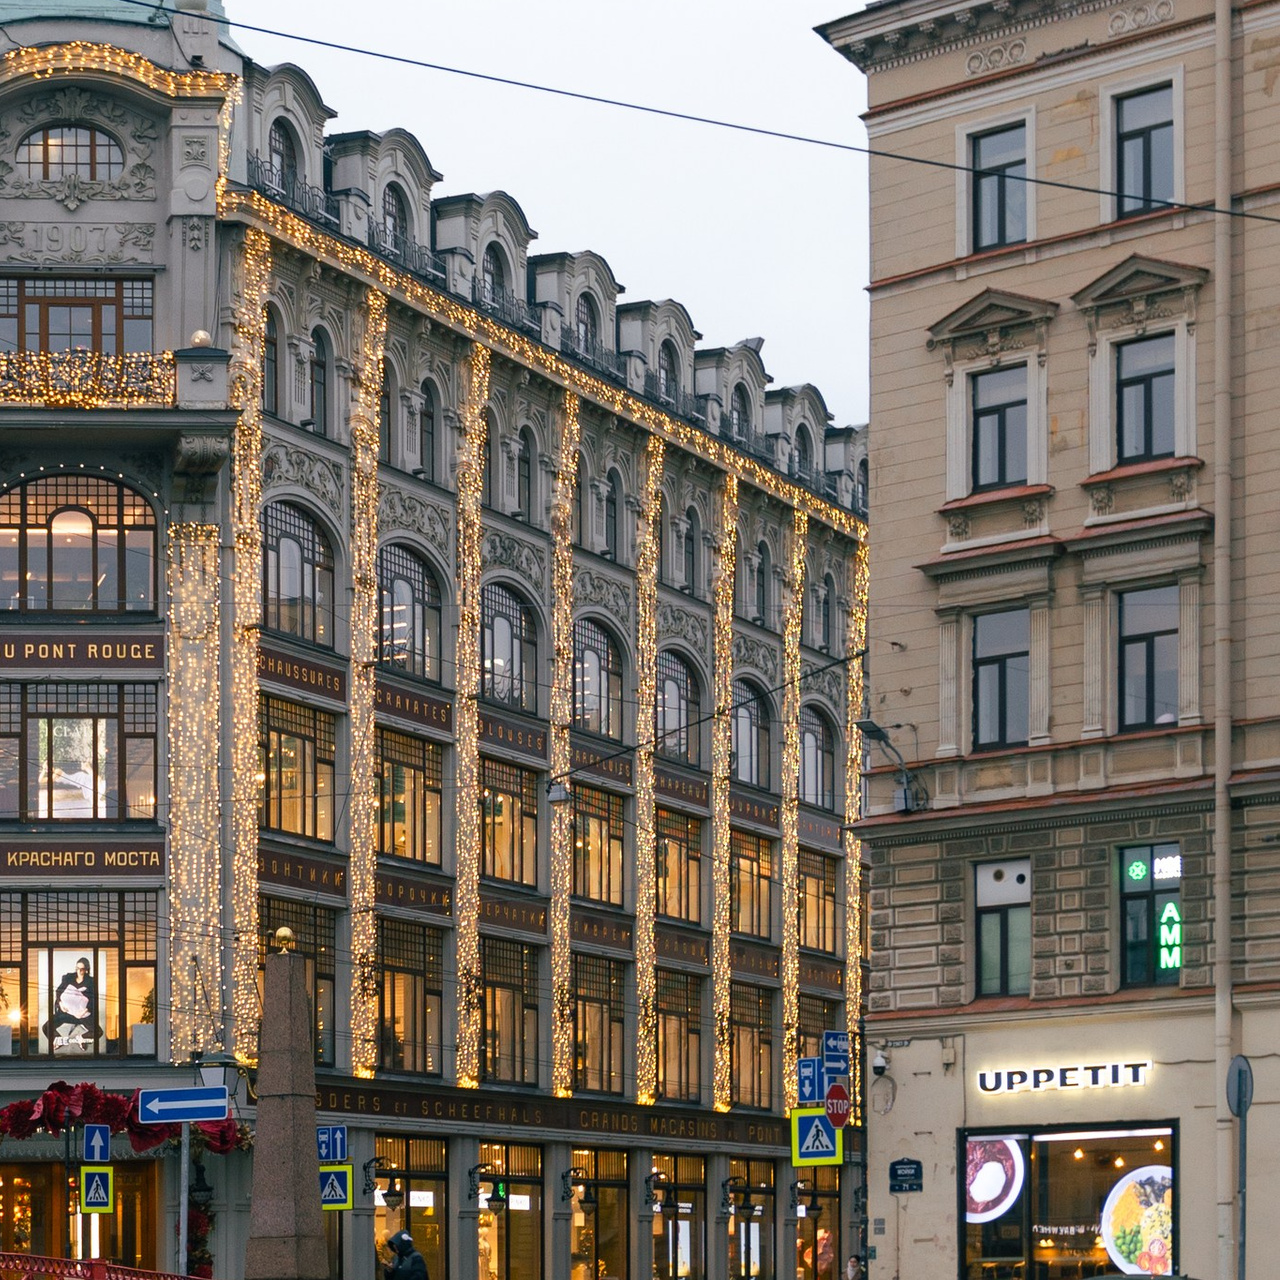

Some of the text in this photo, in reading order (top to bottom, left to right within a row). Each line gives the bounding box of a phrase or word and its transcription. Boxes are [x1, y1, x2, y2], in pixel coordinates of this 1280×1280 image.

[24, 644, 77, 659] PONT
[88, 644, 156, 659] ROUGE
[259, 655, 340, 691] CHAUSSURES
[376, 690, 446, 722] CRAVATES
[7, 851, 95, 866] КРАСНАГО
[104, 851, 160, 866] МОСТА
[259, 858, 341, 886] ЗОНТИКИ
[376, 881, 448, 907] СОРОЧКИ
[979, 1063, 1147, 1091] UPPETIT
[315, 1093, 380, 1111] SDERS
[422, 1101, 542, 1124] SCHEEFHALS
[580, 1111, 638, 1132] GRANDS
[650, 1117, 717, 1138] MAGASINS
[748, 1125, 781, 1142] PONT
[827, 1099, 849, 1114] STOP
